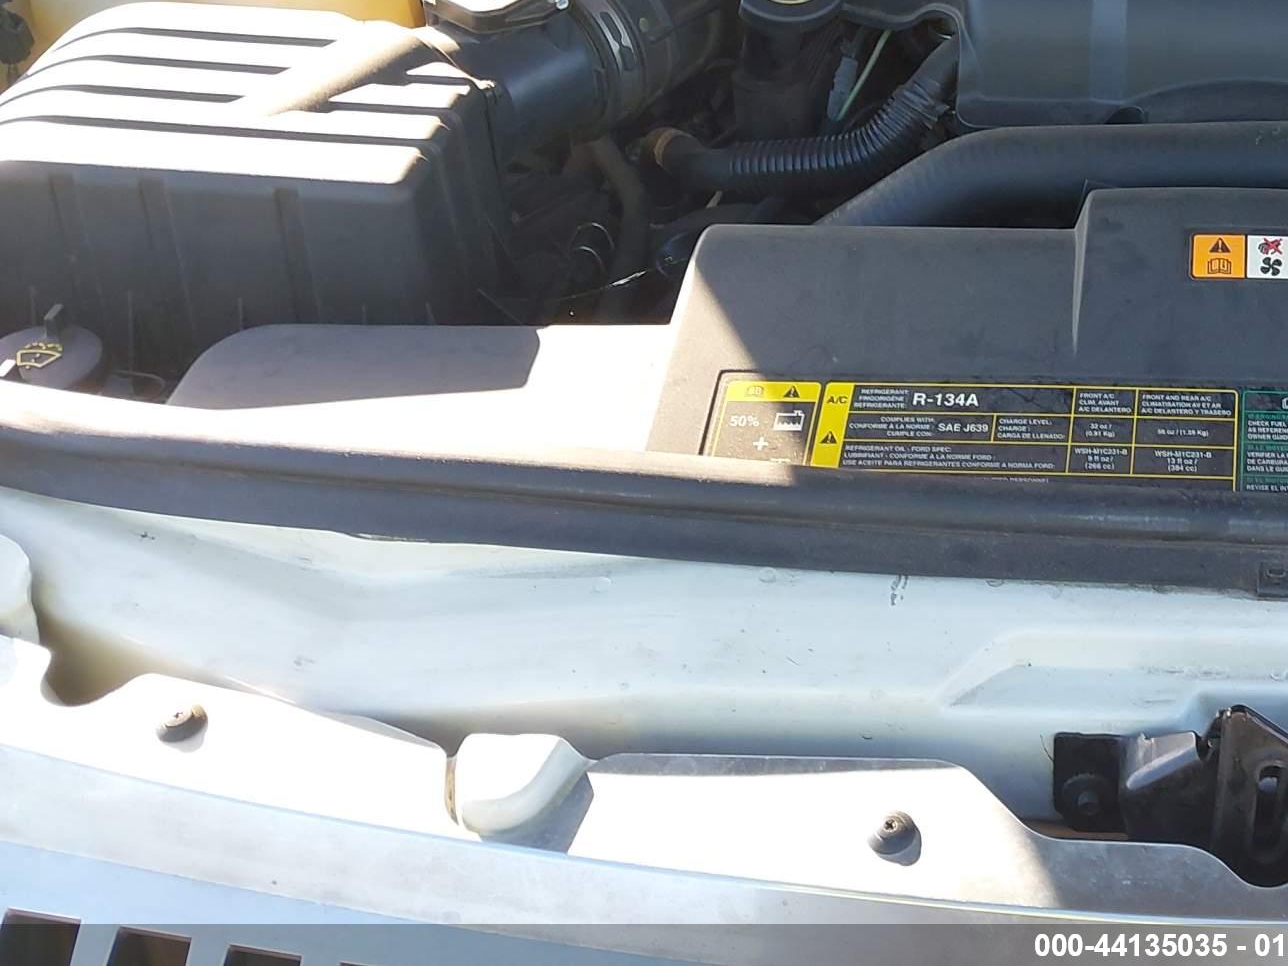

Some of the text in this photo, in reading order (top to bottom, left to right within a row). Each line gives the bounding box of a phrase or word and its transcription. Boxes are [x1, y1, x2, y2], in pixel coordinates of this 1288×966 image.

[827, 394, 848, 405] A/C
[912, 392, 979, 407] R-134A
[729, 414, 760, 427] 50%
[938, 423, 989, 433] SAE J639
